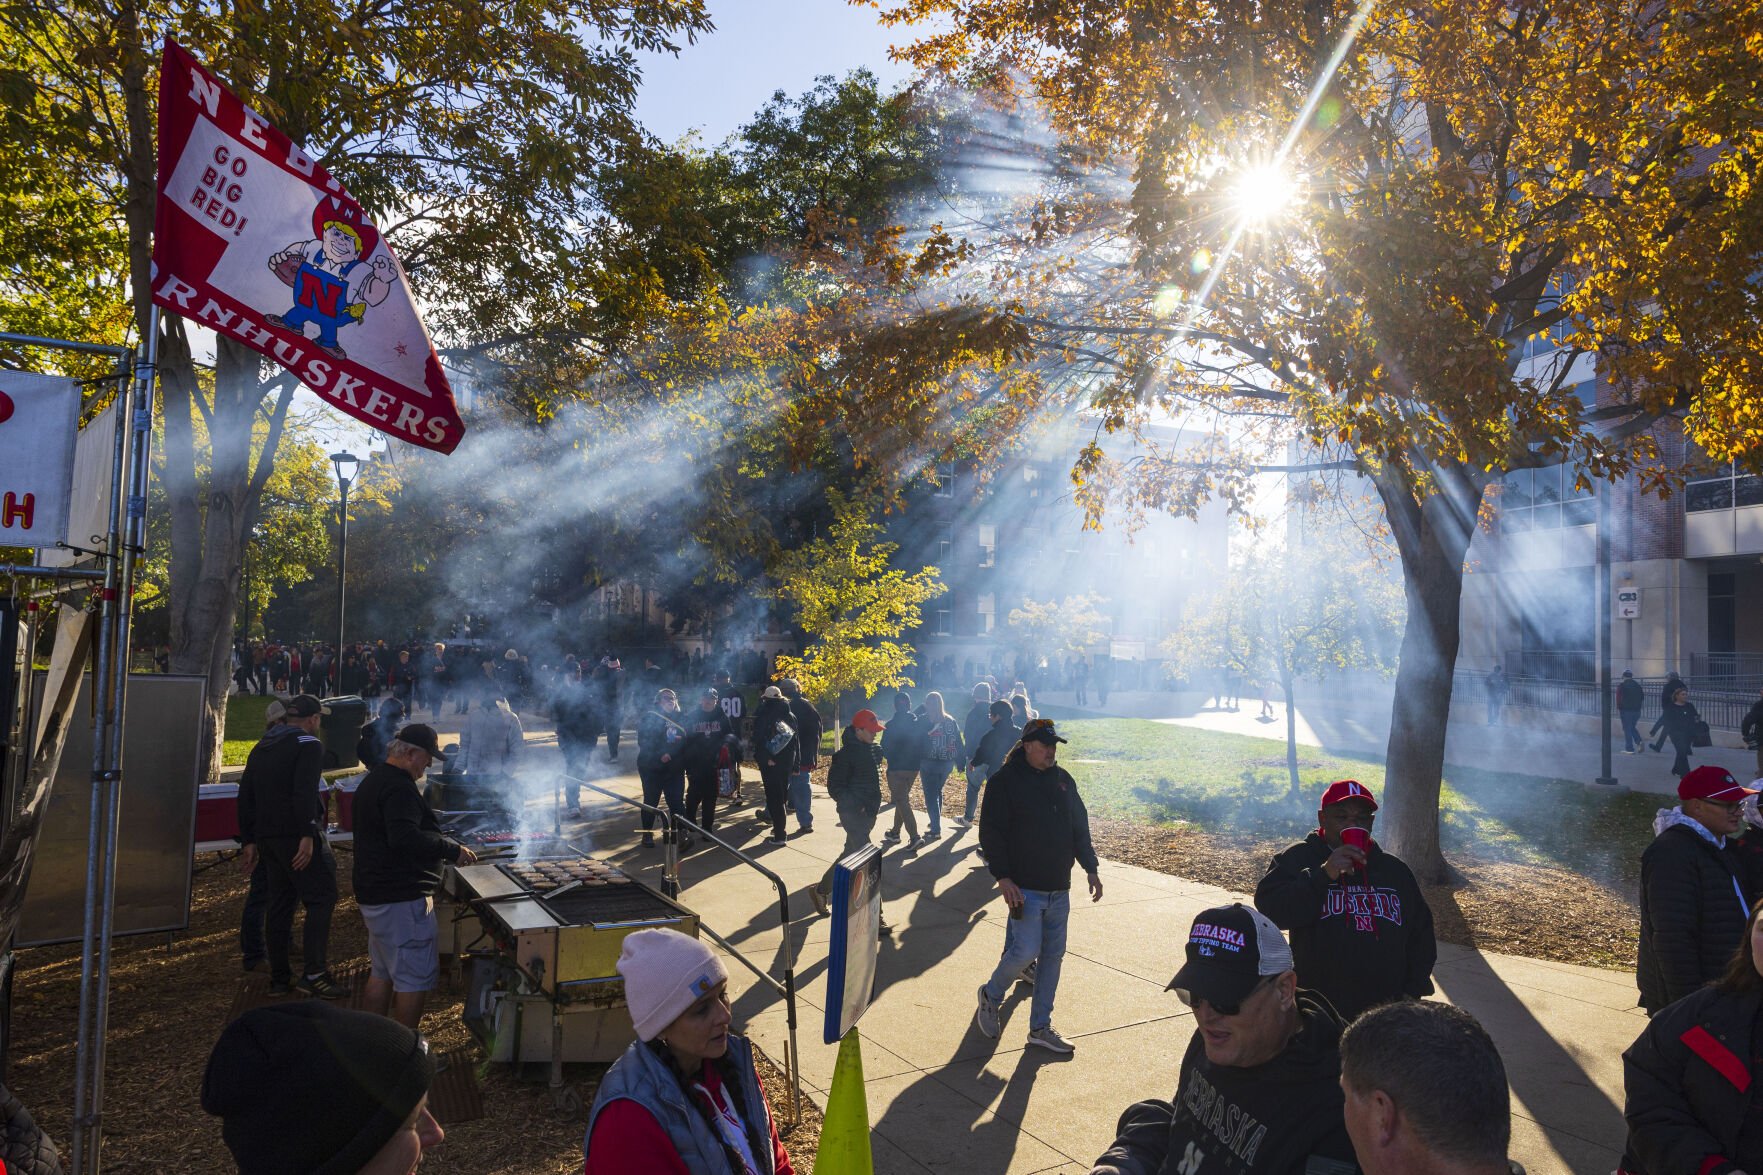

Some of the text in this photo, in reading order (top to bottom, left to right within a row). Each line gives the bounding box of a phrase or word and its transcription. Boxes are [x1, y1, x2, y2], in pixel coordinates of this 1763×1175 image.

[213, 145, 248, 178] GO
[201, 164, 243, 203] BIG
[190, 186, 248, 237] RED!
[344, 208, 354, 219] N
[298, 270, 343, 319] N
[720, 696, 742, 718] 90
[1348, 782, 1361, 796] N
[1354, 915, 1374, 932] N
[1221, 942, 1240, 953] TEAM
